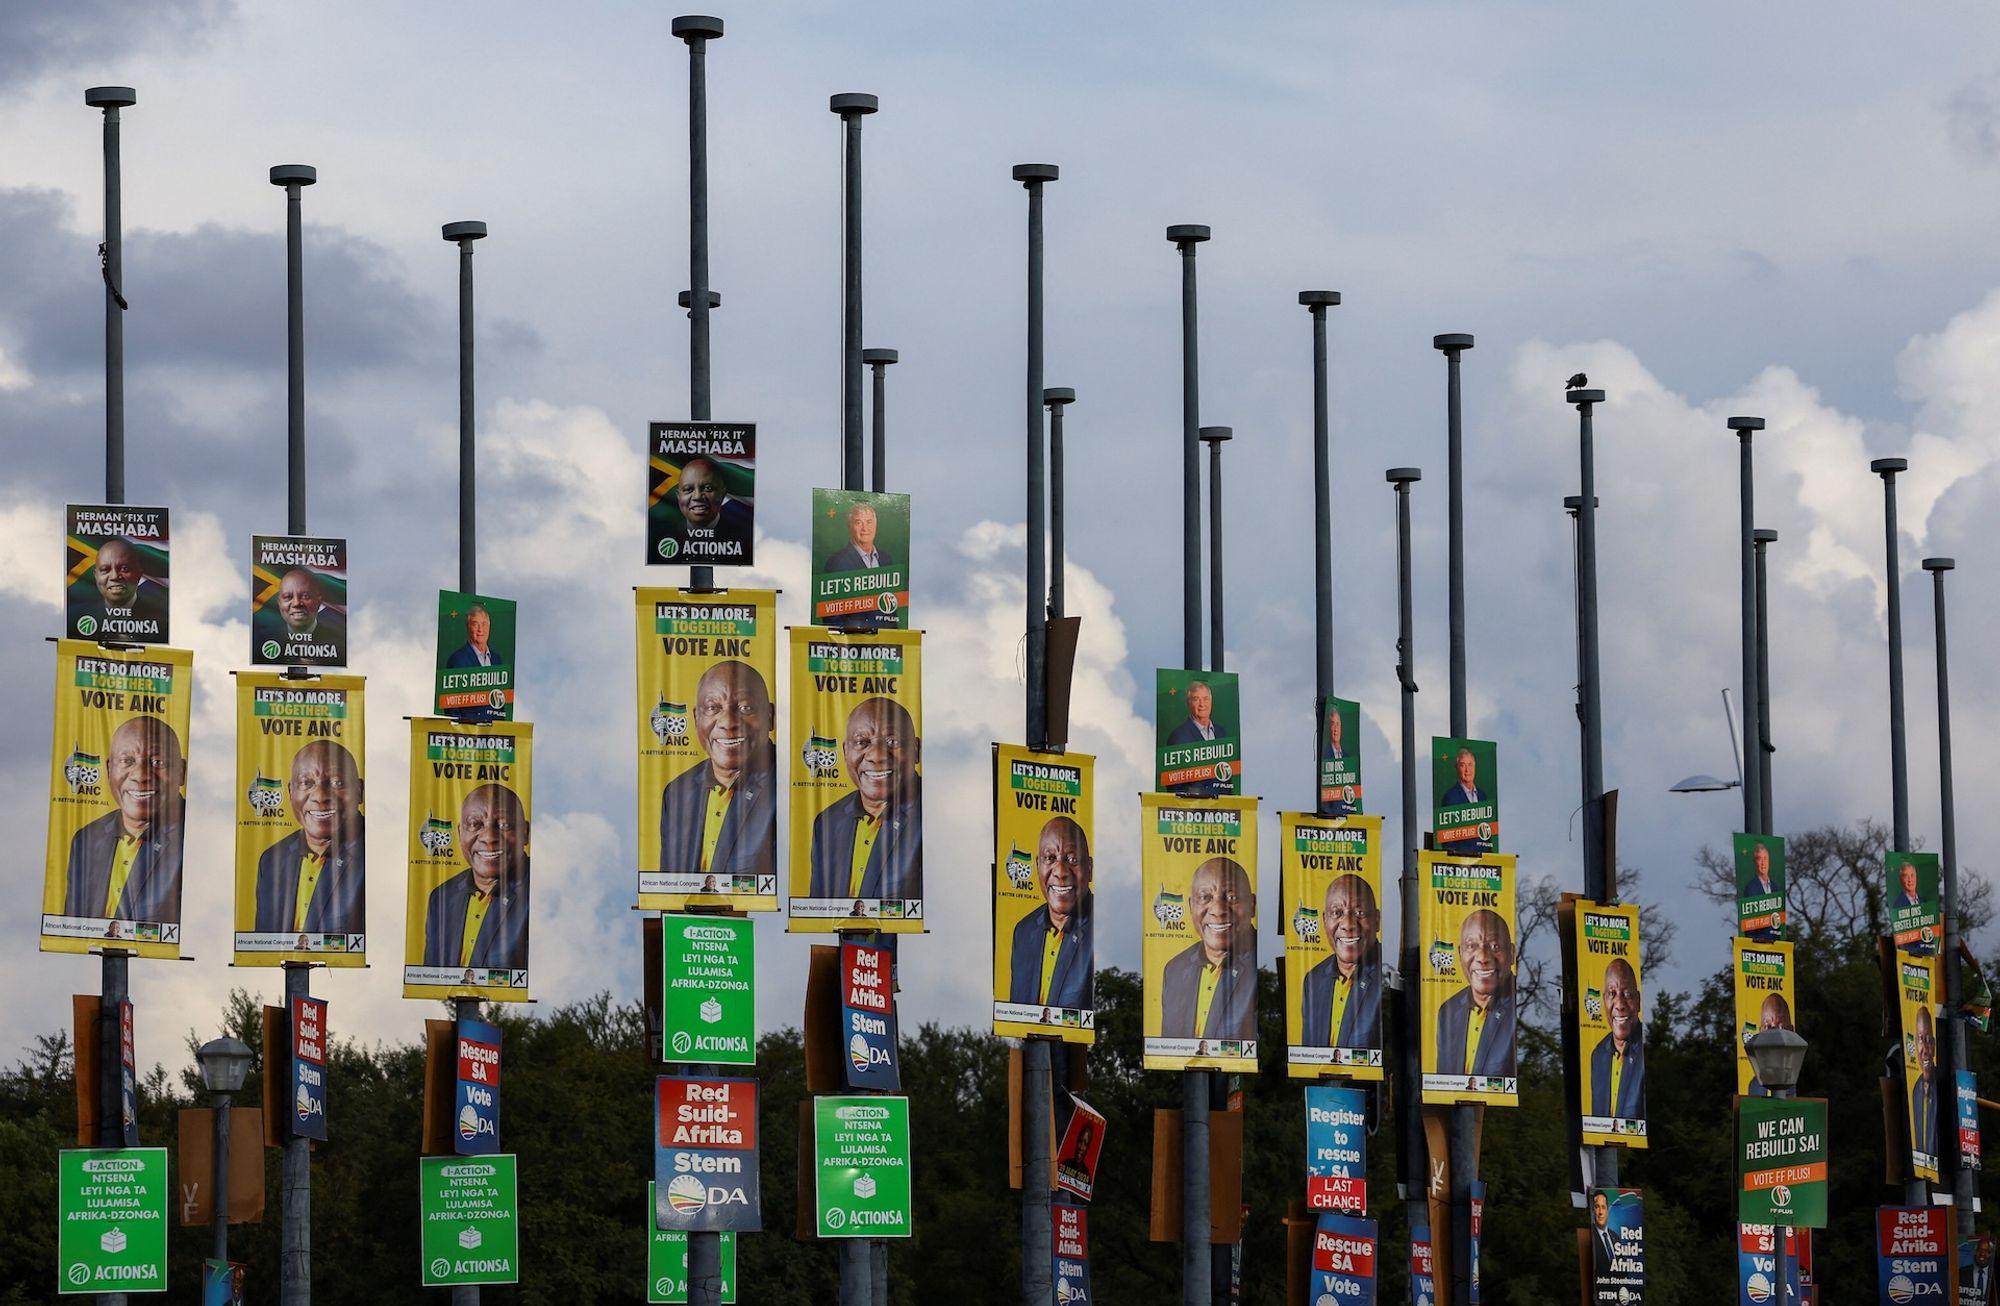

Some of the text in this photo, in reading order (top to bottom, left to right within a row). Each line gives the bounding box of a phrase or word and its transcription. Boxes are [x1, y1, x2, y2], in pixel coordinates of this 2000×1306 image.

[660, 430, 706, 439] HERMAN
[659, 440, 745, 454] MASHABA
[76, 512, 122, 521] HERMAN
[76, 522, 159, 536] MASHABA
[687, 529, 714, 538] VOTE
[261, 543, 303, 551] HERMAN
[683, 541, 742, 555] ACTIONSA
[261, 552, 338, 566] MASHABA
[820, 572, 900, 595] LET'S REBUILD
[106, 608, 132, 616] VOTE
[825, 598, 873, 613] VOTE FF PLUS!
[658, 605, 754, 624] LET'S DO MORE,
[102, 619, 159, 633] ACTIONSA
[672, 620, 740, 634] TOGETHER.
[288, 633, 312, 641] VOTE
[284, 644, 338, 658] ACTIONSA
[663, 637, 750, 657] VOTE ANC
[77, 660, 170, 682] LET'S DO MORE,
[90, 675, 155, 691] TOGETHER.
[443, 671, 508, 689] LET'S REBUILD
[815, 675, 897, 694] VOTE ANC
[81, 690, 165, 713] VOTE ANC
[666, 736, 689, 746] ANC
[1164, 744, 1233, 766] LET'S REBUILD
[1013, 763, 1078, 784] LET'S DO MORE,
[1169, 766, 1212, 781] VOTE FF PLUS!
[1022, 778, 1069, 793] TOGETHER.
[1016, 792, 1076, 814] VOTE ANC
[1439, 806, 1492, 825] LET'S REBUILD
[1164, 837, 1236, 854] VOTE ANC
[1301, 854, 1363, 871] VOTE ANC
[1437, 890, 1498, 907] VOTE ANC
[1742, 897, 1782, 915] LET'S REBUILD
[690, 929, 731, 939] I-ACTION
[692, 942, 728, 952] NTSENA
[1588, 938, 1628, 956] VOTE ANC
[682, 954, 738, 964] LEYI NGA TA
[856, 950, 878, 968] Red
[688, 967, 733, 977] LULAMISA
[852, 968, 882, 988] Suid-
[671, 979, 749, 990] AFRIKA-DZONGA
[1745, 974, 1783, 991] VOTE ANC
[851, 988, 885, 1008] Afrika
[302, 1002, 317, 1021] Red
[300, 1021, 320, 1041] Suid-
[852, 1013, 886, 1035] Stem
[298, 1039, 321, 1060] Afrika
[695, 1036, 748, 1052] ACTIONSA
[460, 1041, 498, 1064] Rescue
[870, 1048, 891, 1065] DA
[299, 1064, 321, 1086] Stem
[472, 1062, 487, 1081] SA
[466, 1086, 492, 1106] Vote
[686, 1084, 729, 1102] Red
[310, 1097, 322, 1115] DA
[678, 1105, 737, 1123] Suid-
[1310, 1108, 1364, 1126] Register
[479, 1118, 494, 1135] DA
[1758, 1117, 1804, 1139] WE CAN
[673, 1126, 742, 1144] Afrika
[1334, 1131, 1348, 1145] to
[1965, 1132, 1975, 1142] LAST
[1746, 1134, 1819, 1160] REBUILD SA!
[1962, 1142, 1979, 1154] CHANCE
[674, 1153, 740, 1173] Stem
[823, 1158, 903, 1166] AFRIKA-DZONGA
[1318, 1148, 1360, 1163] rescue
[89, 1160, 138, 1170] I-ACTION
[448, 1167, 490, 1175] I-ACTION
[1332, 1165, 1349, 1178] SA
[92, 1174, 135, 1183] NTSENA
[450, 1178, 488, 1186] NTSENA
[1753, 1167, 1810, 1186] VOTE FF PLUS!
[81, 1186, 146, 1196] LEYI NGA TA
[1324, 1180, 1352, 1193] LAST
[87, 1198, 140, 1208] LULAMISA
[707, 1187, 748, 1205] DA
[1313, 1194, 1360, 1209] CHANCE
[446, 1200, 493, 1208] LULAMISA
[67, 1210, 160, 1221] AFRIKA-DZONGA
[429, 1211, 510, 1220] AFRIKA-DZONGA
[849, 1211, 903, 1224] ACTIONSA
[1062, 1210, 1077, 1223] Red
[1898, 1211, 1928, 1224] Red
[1059, 1224, 1080, 1239] Suid-
[1621, 1227, 1642, 1240] Red
[1893, 1226, 1934, 1239] Suid-
[1058, 1240, 1082, 1256] Afrika
[1317, 1233, 1373, 1256] Rescue
[1614, 1243, 1643, 1257] Suid-
[1891, 1240, 1938, 1254] Afrika
[454, 1259, 510, 1273] ACTIONSA
[1059, 1261, 1082, 1277] Stem
[1332, 1254, 1353, 1272] SA
[1610, 1259, 1643, 1272] Afrika
[1892, 1260, 1937, 1274] Stem
[94, 1265, 158, 1280] ACTIONSA
[1071, 1286, 1086, 1300] DA
[1324, 1276, 1361, 1296] Vote
[1914, 1282, 1942, 1294] DA
[1598, 1292, 1641, 1300] STEM DA
